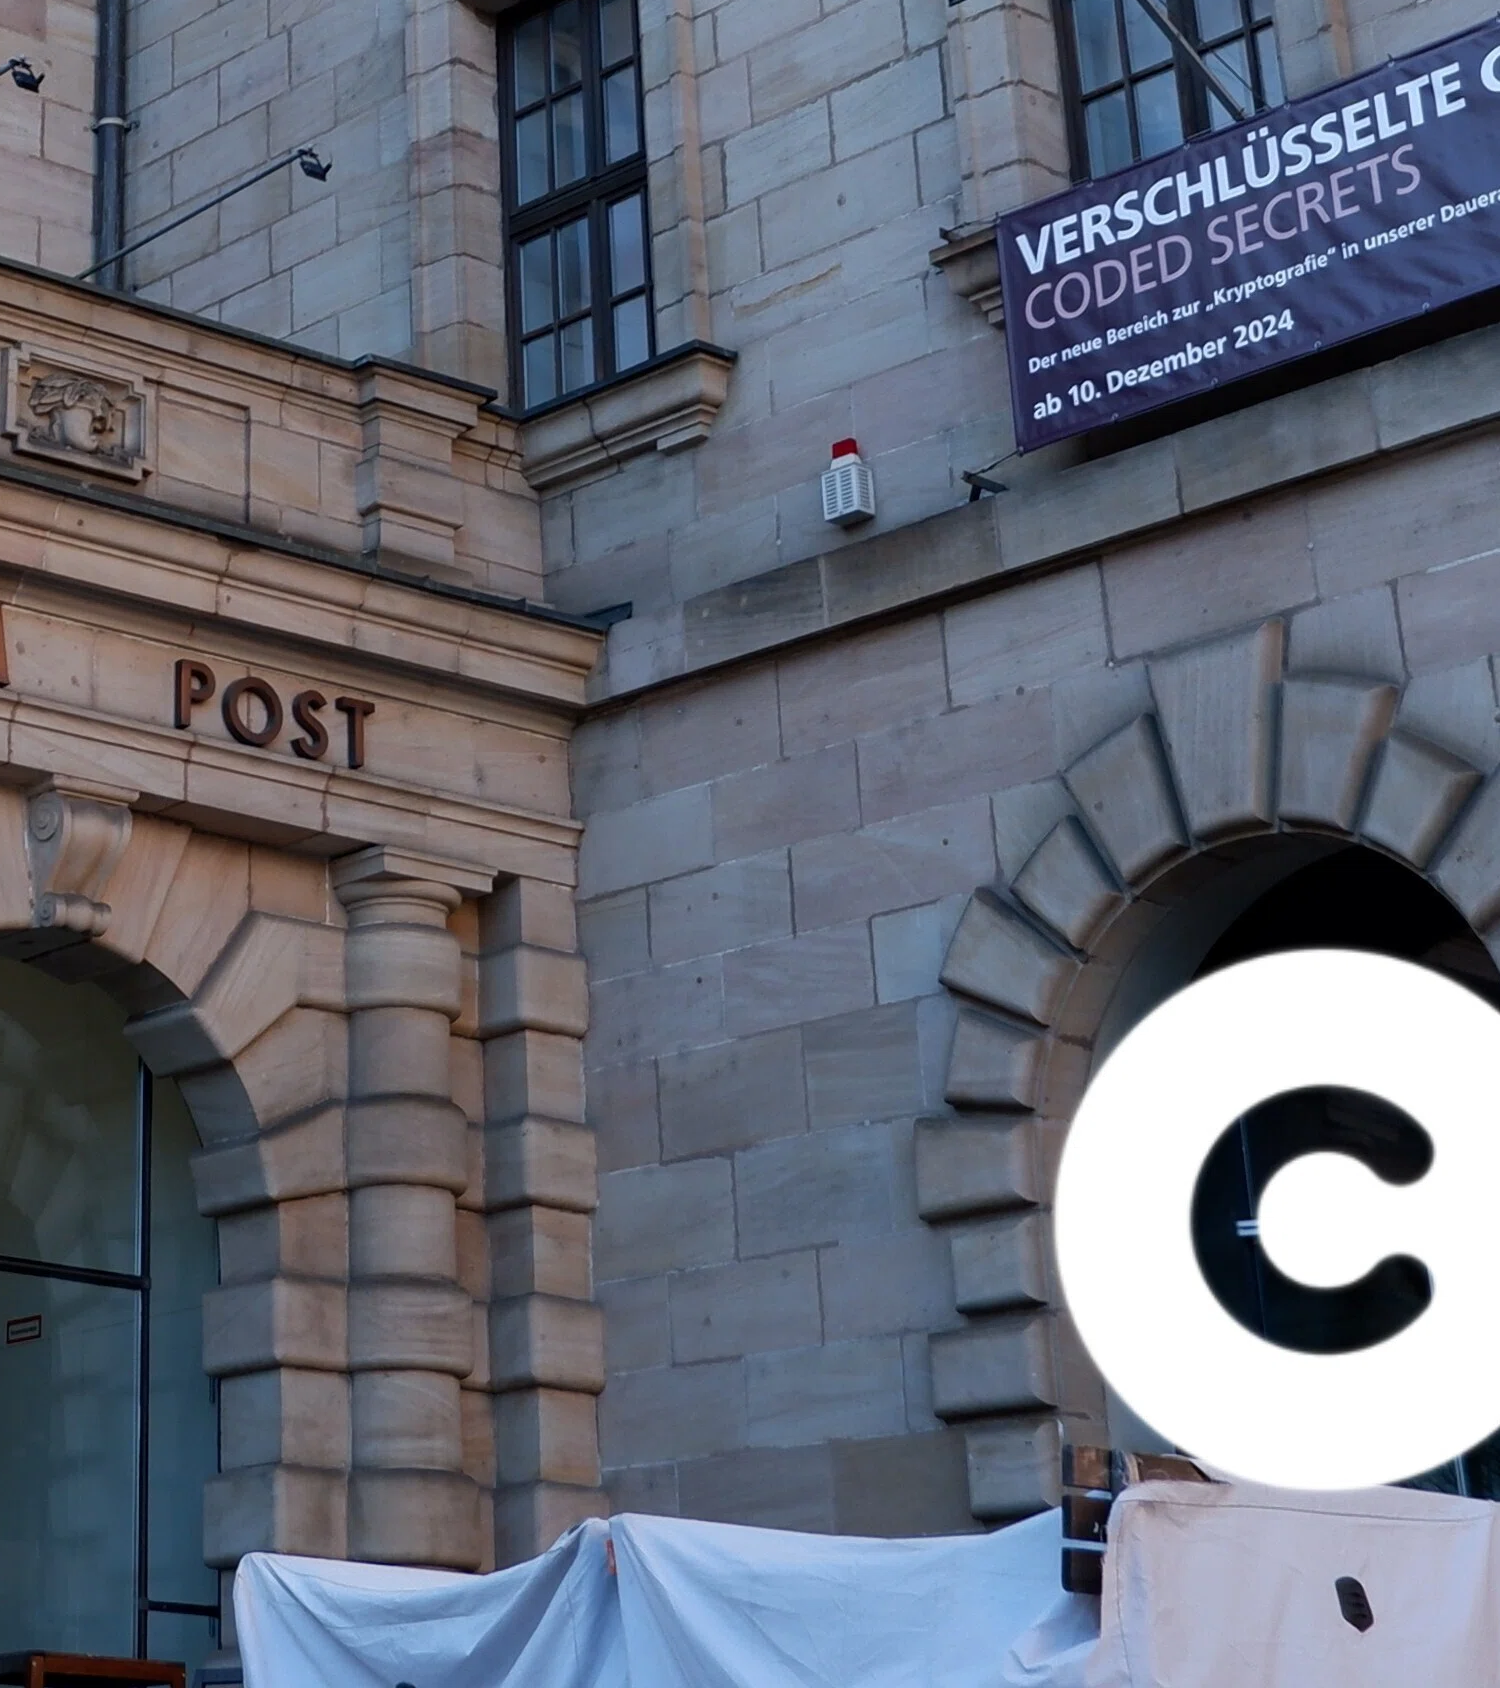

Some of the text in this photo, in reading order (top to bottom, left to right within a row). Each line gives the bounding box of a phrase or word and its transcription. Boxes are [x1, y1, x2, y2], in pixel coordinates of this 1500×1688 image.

[1015, 62, 1468, 275] VERSCHLÜSSELTE
[1024, 143, 1422, 331] CODED SECRETS
[1028, 353, 1057, 374] Der
[1061, 337, 1104, 363] neue
[1106, 310, 1169, 346] Bereich
[1171, 300, 1201, 322] zur
[1341, 241, 1360, 260] in
[1364, 212, 1436, 252] unserer
[1032, 308, 1295, 421] ab 10. Dezember 2024
[174, 657, 375, 770] POST
